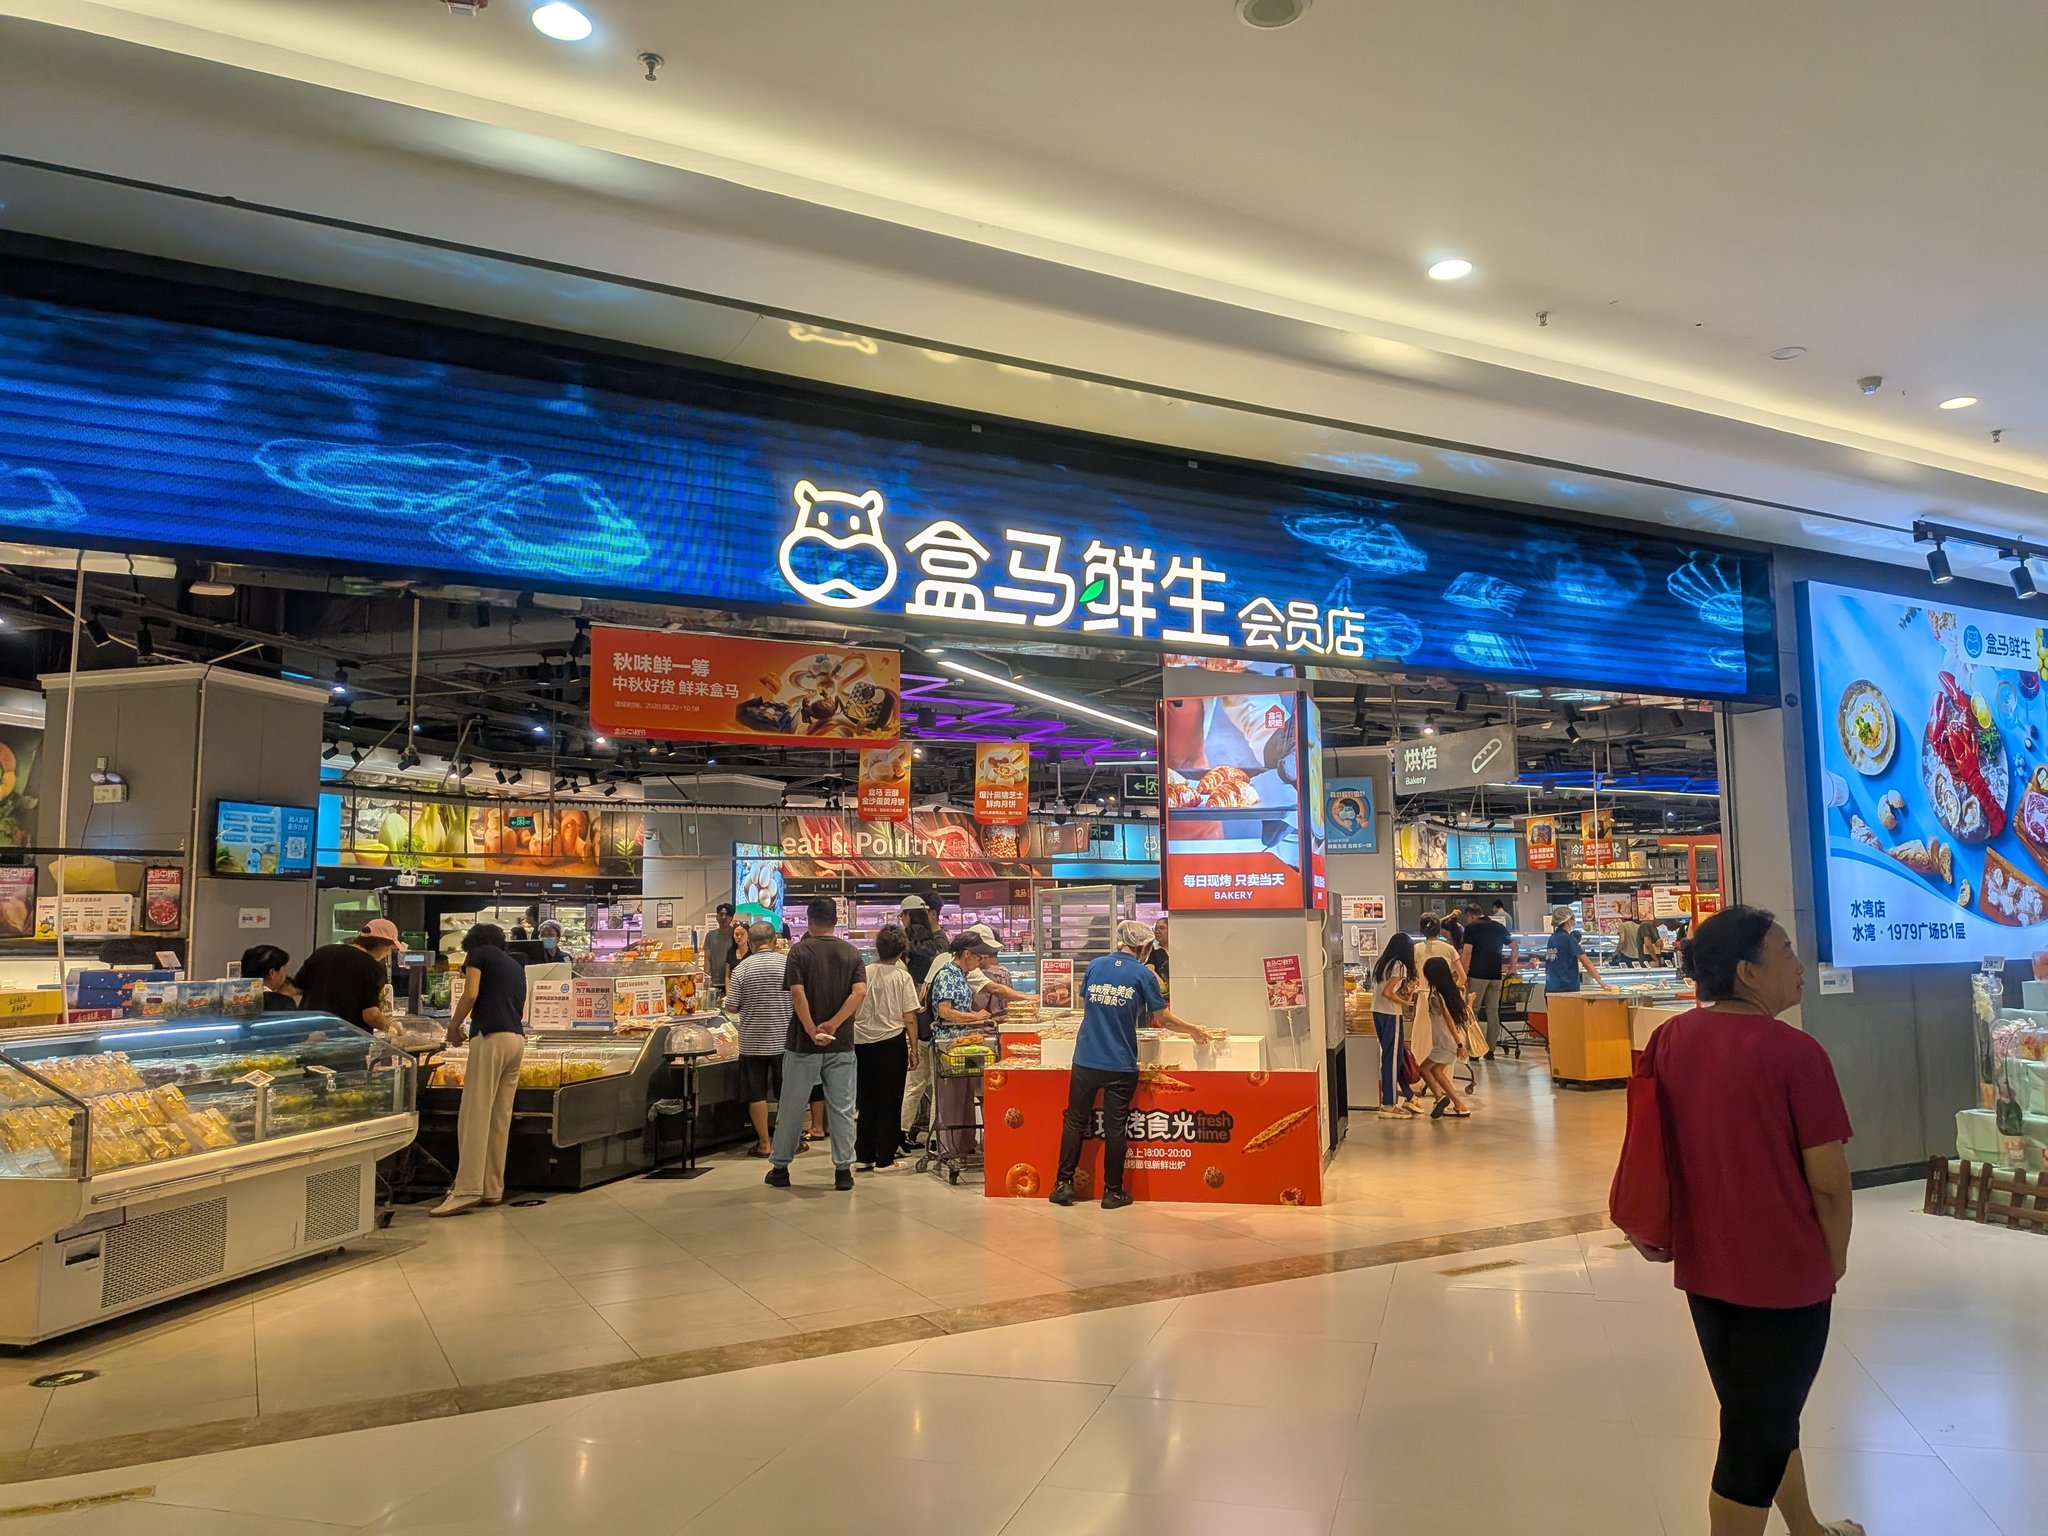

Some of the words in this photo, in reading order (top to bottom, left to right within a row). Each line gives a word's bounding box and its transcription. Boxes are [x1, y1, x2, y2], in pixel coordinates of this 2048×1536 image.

[904, 520, 1231, 647] 盒马鲜生
[1237, 596, 1367, 658] 会员店
[1985, 633, 2032, 660] 盒马鲜生
[613, 652, 710, 677] 秋味鲜一筹
[612, 675, 675, 695] 中秋好货
[678, 680, 739, 699] 鲜来盒马
[1404, 745, 1438, 773] 烘焙
[1405, 776, 1427, 785] Bakery
[868, 787, 883, 797] 盒马
[985, 800, 1016, 809] 鲜肉月饼
[781, 832, 823, 855] eat
[832, 832, 849, 855] &
[857, 831, 947, 858] Poultry
[1183, 874, 1232, 888] 每日现烤
[1235, 873, 1285, 887] 只卖当天
[1213, 891, 1253, 900] BAKERY
[1850, 899, 1886, 919] 水湾店
[576, 997, 593, 1007] 当日
[1089, 993, 1118, 1007] 不可辜负
[576, 1008, 593, 1018] 出清
[1197, 1113, 1231, 1127] fresh
[1198, 1128, 1228, 1140] time
